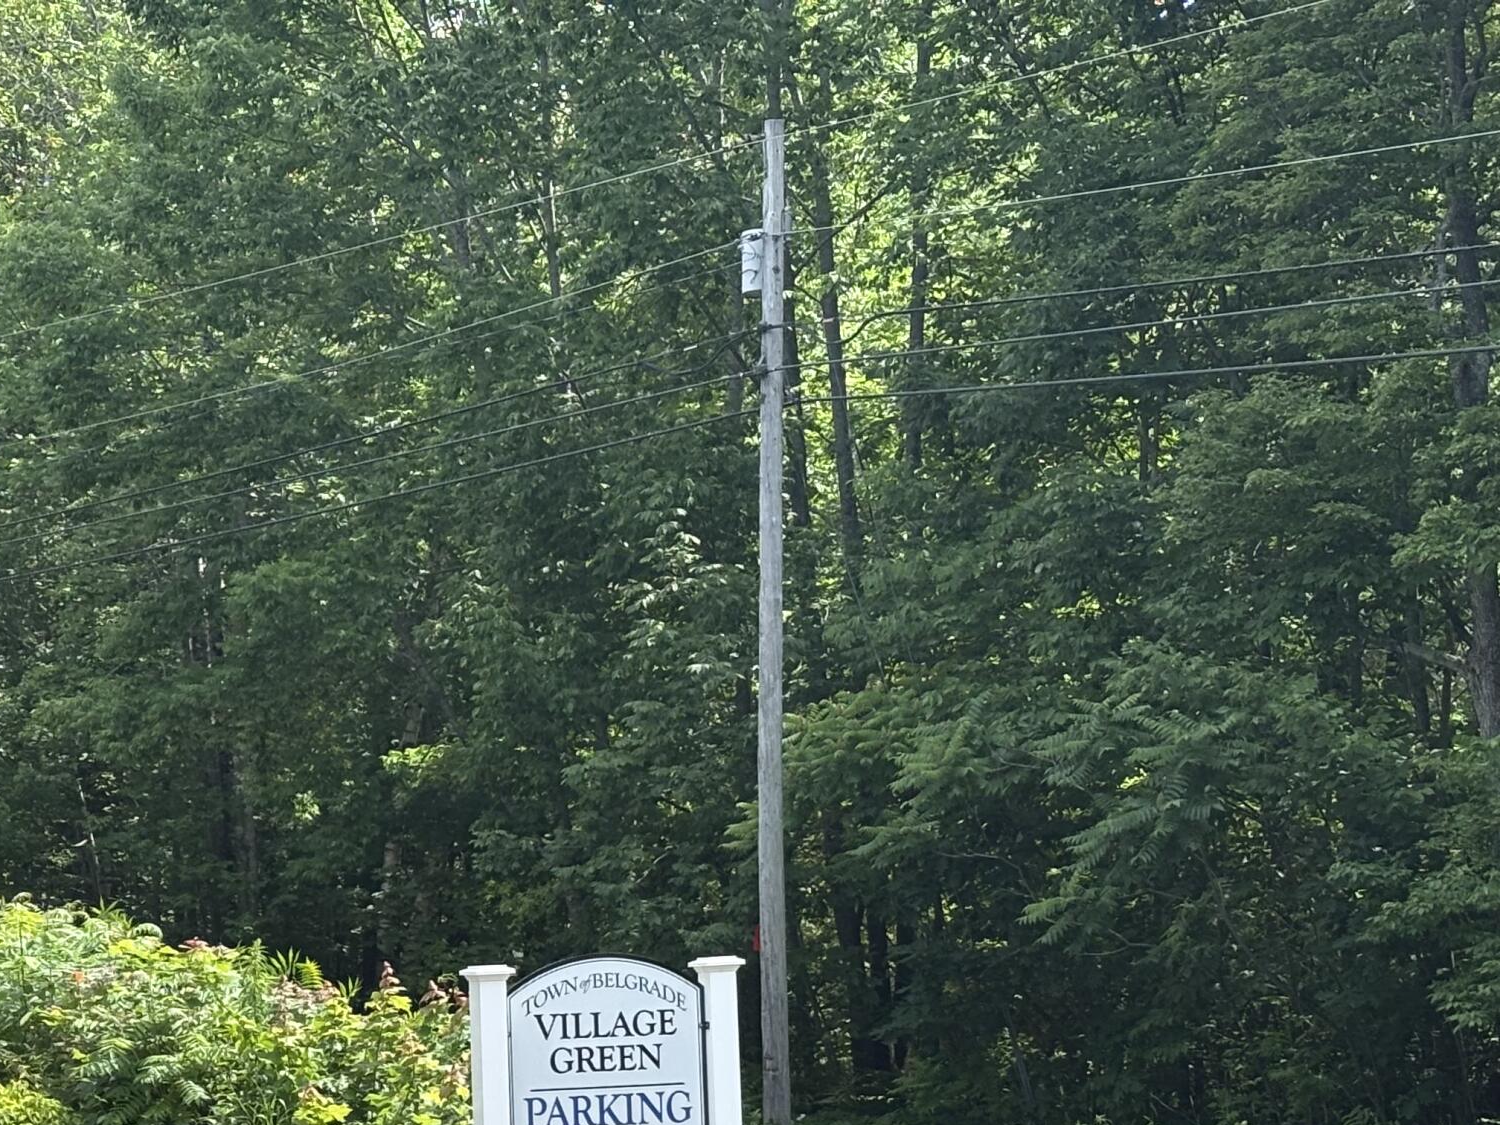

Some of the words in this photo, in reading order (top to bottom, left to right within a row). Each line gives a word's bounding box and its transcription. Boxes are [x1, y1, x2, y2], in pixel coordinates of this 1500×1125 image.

[522, 976, 578, 1017] TOWN
[579, 974, 593, 993] of
[592, 972, 687, 1011] BELGRADE
[534, 1009, 677, 1040] VILLAGE
[550, 1043, 662, 1074] GREEN
